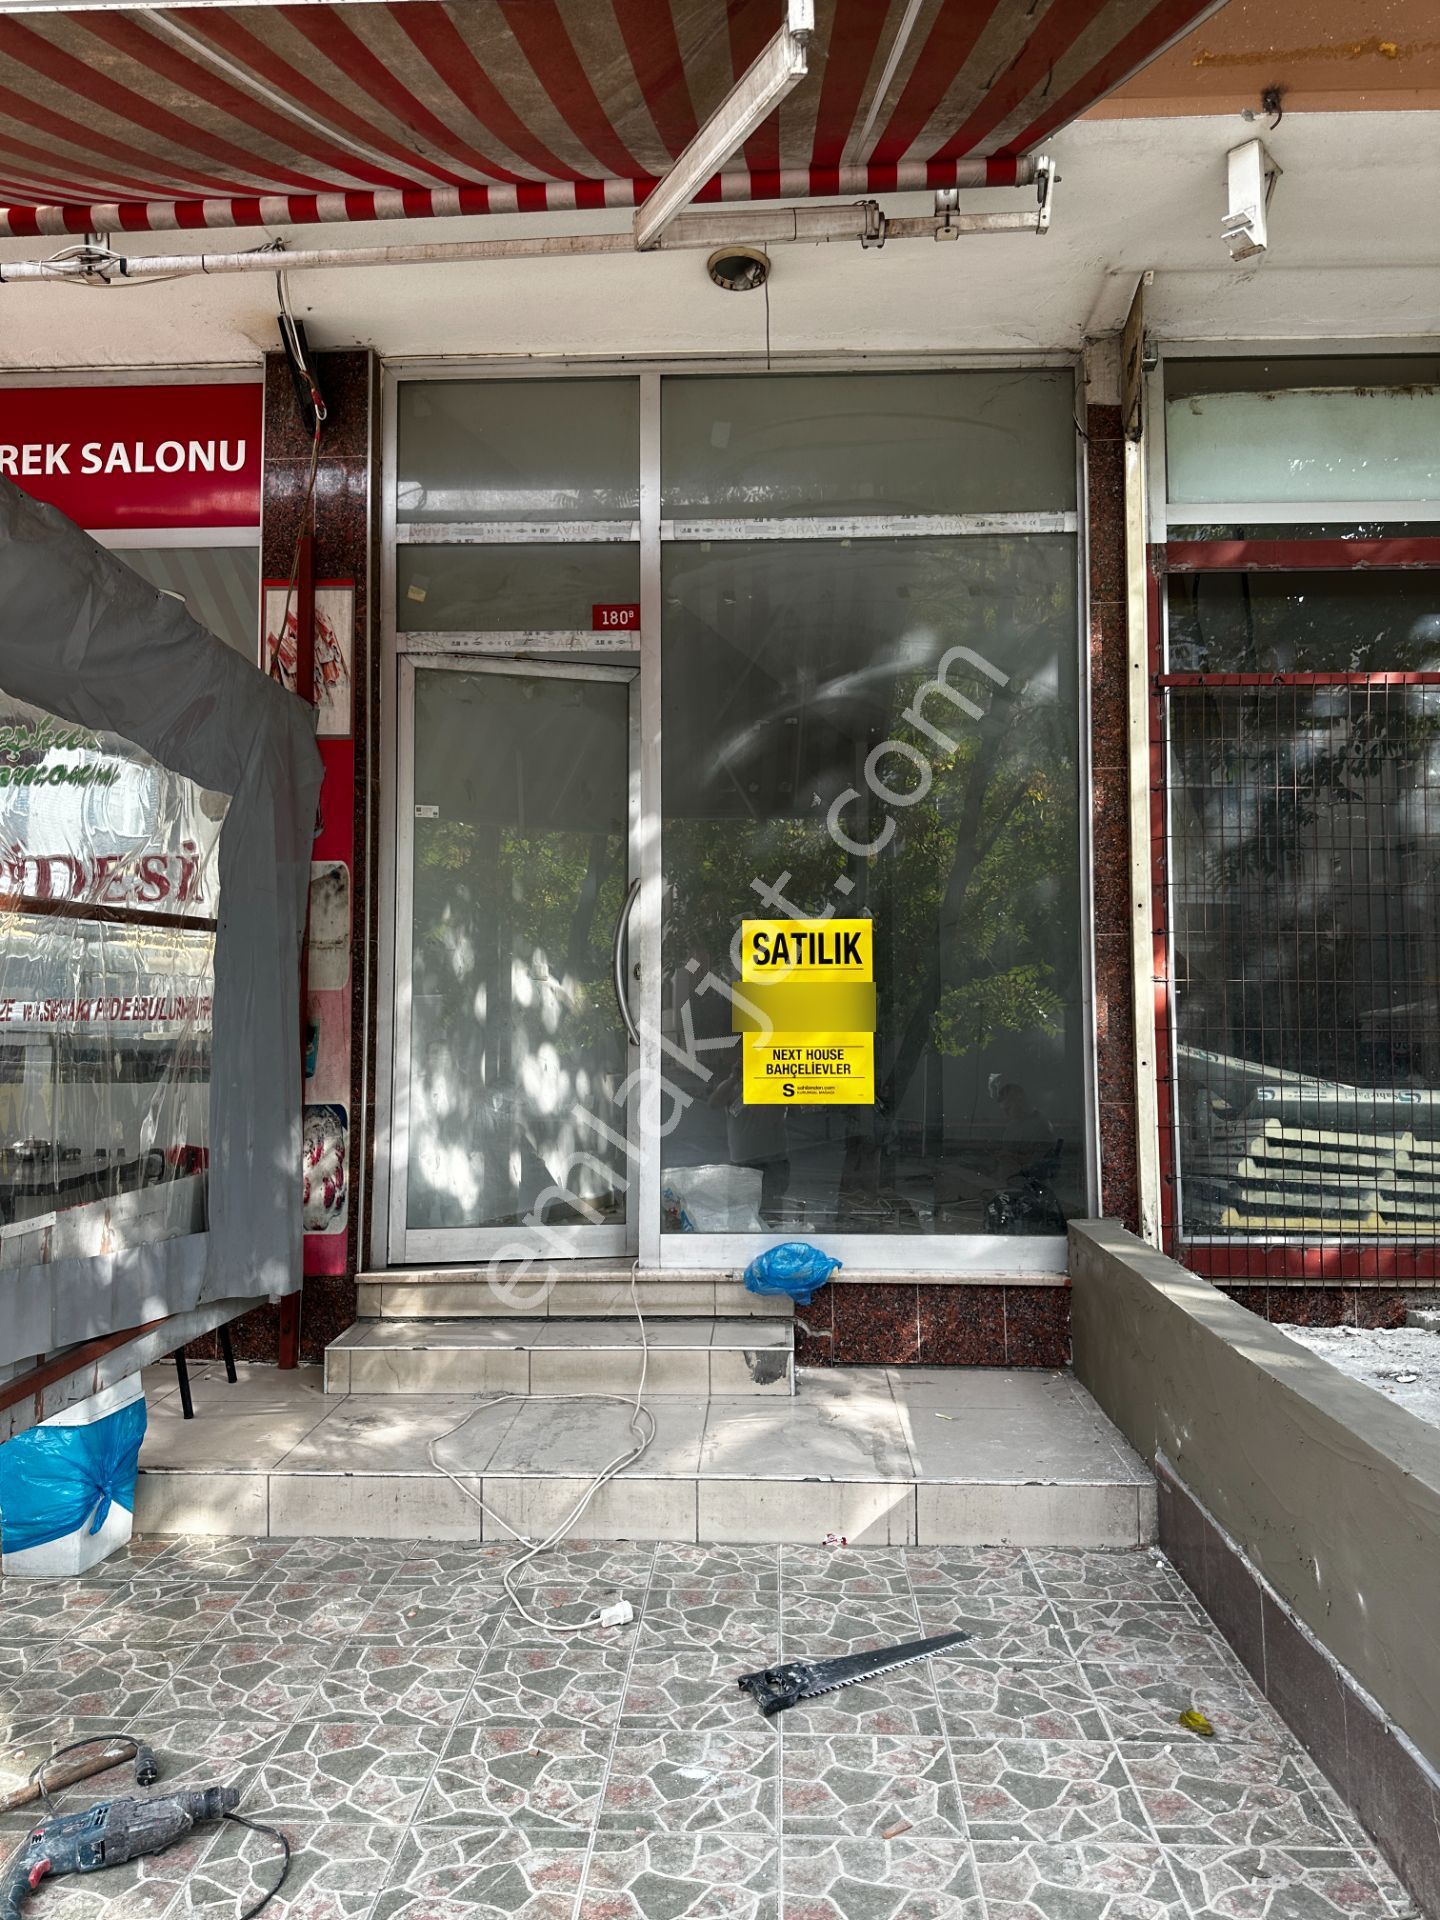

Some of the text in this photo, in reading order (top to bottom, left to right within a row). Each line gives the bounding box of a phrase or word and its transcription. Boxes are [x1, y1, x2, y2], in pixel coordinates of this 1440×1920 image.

[80, 440, 246, 474] SALONU
[752, 932, 863, 966] SATILIK
[772, 1049, 844, 1061] NEXT HOUSE
[766, 1062, 851, 1078] BAHÇELİEVLER
